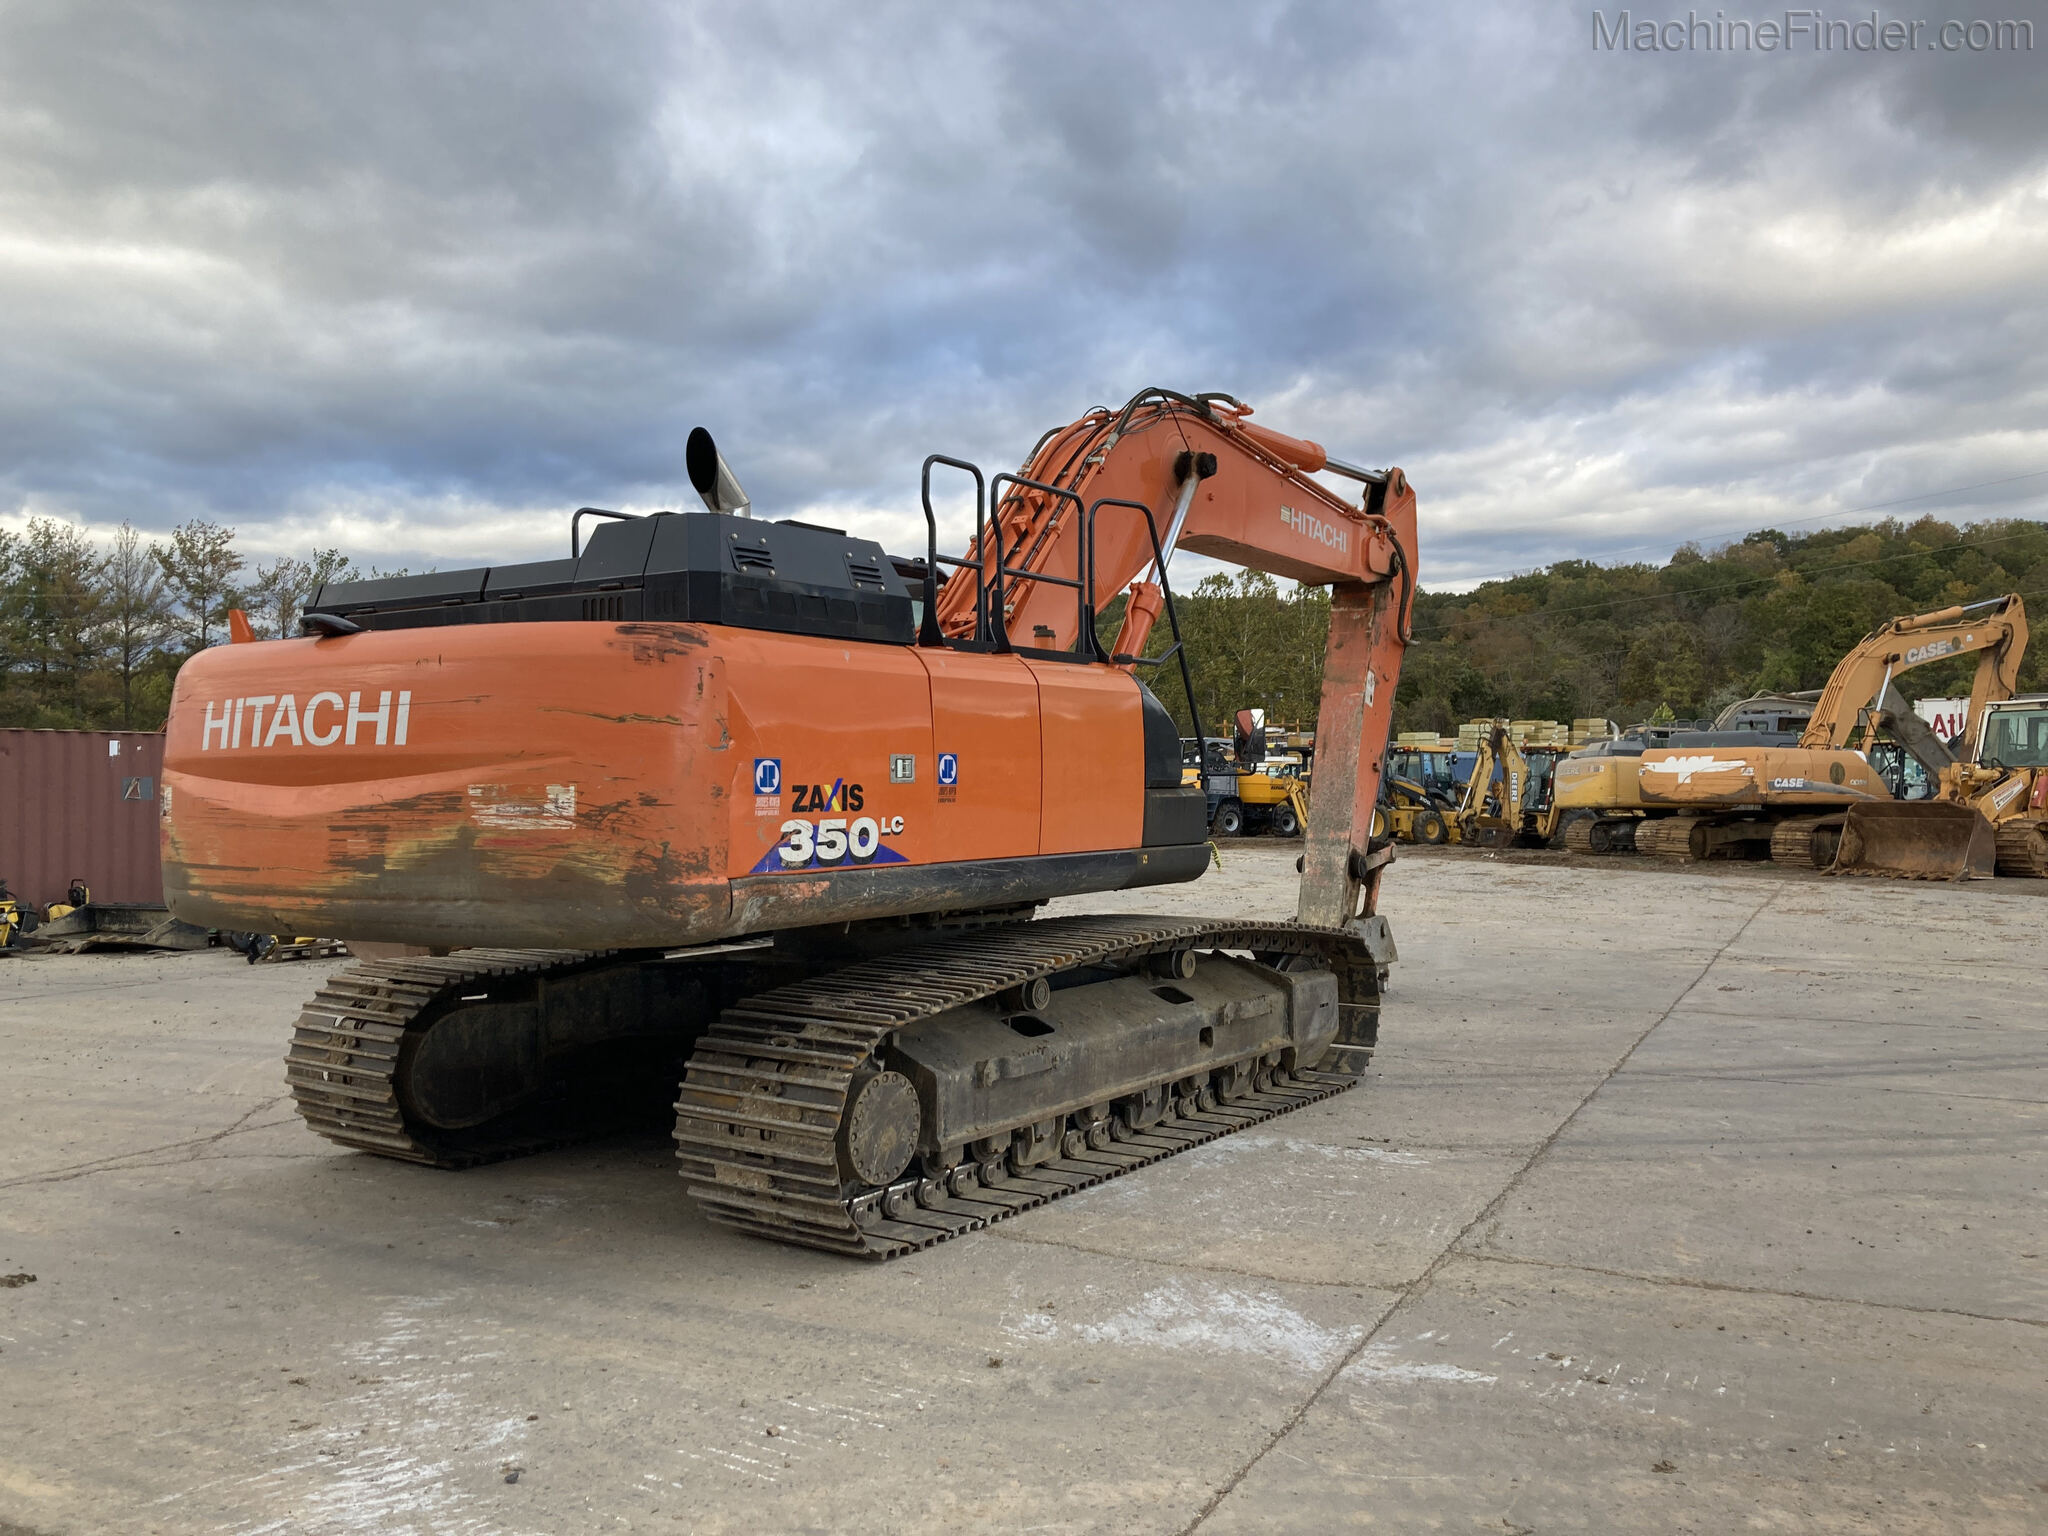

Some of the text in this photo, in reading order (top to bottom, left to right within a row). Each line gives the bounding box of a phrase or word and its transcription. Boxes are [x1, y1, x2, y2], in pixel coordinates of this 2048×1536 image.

[1291, 507, 1347, 553] HITACHI
[1907, 640, 1947, 662] CASE
[202, 691, 411, 751] HITACHI
[791, 778, 864, 812] ZAXIS
[1774, 778, 1805, 788] CASE
[778, 816, 904, 866] 350 LC
